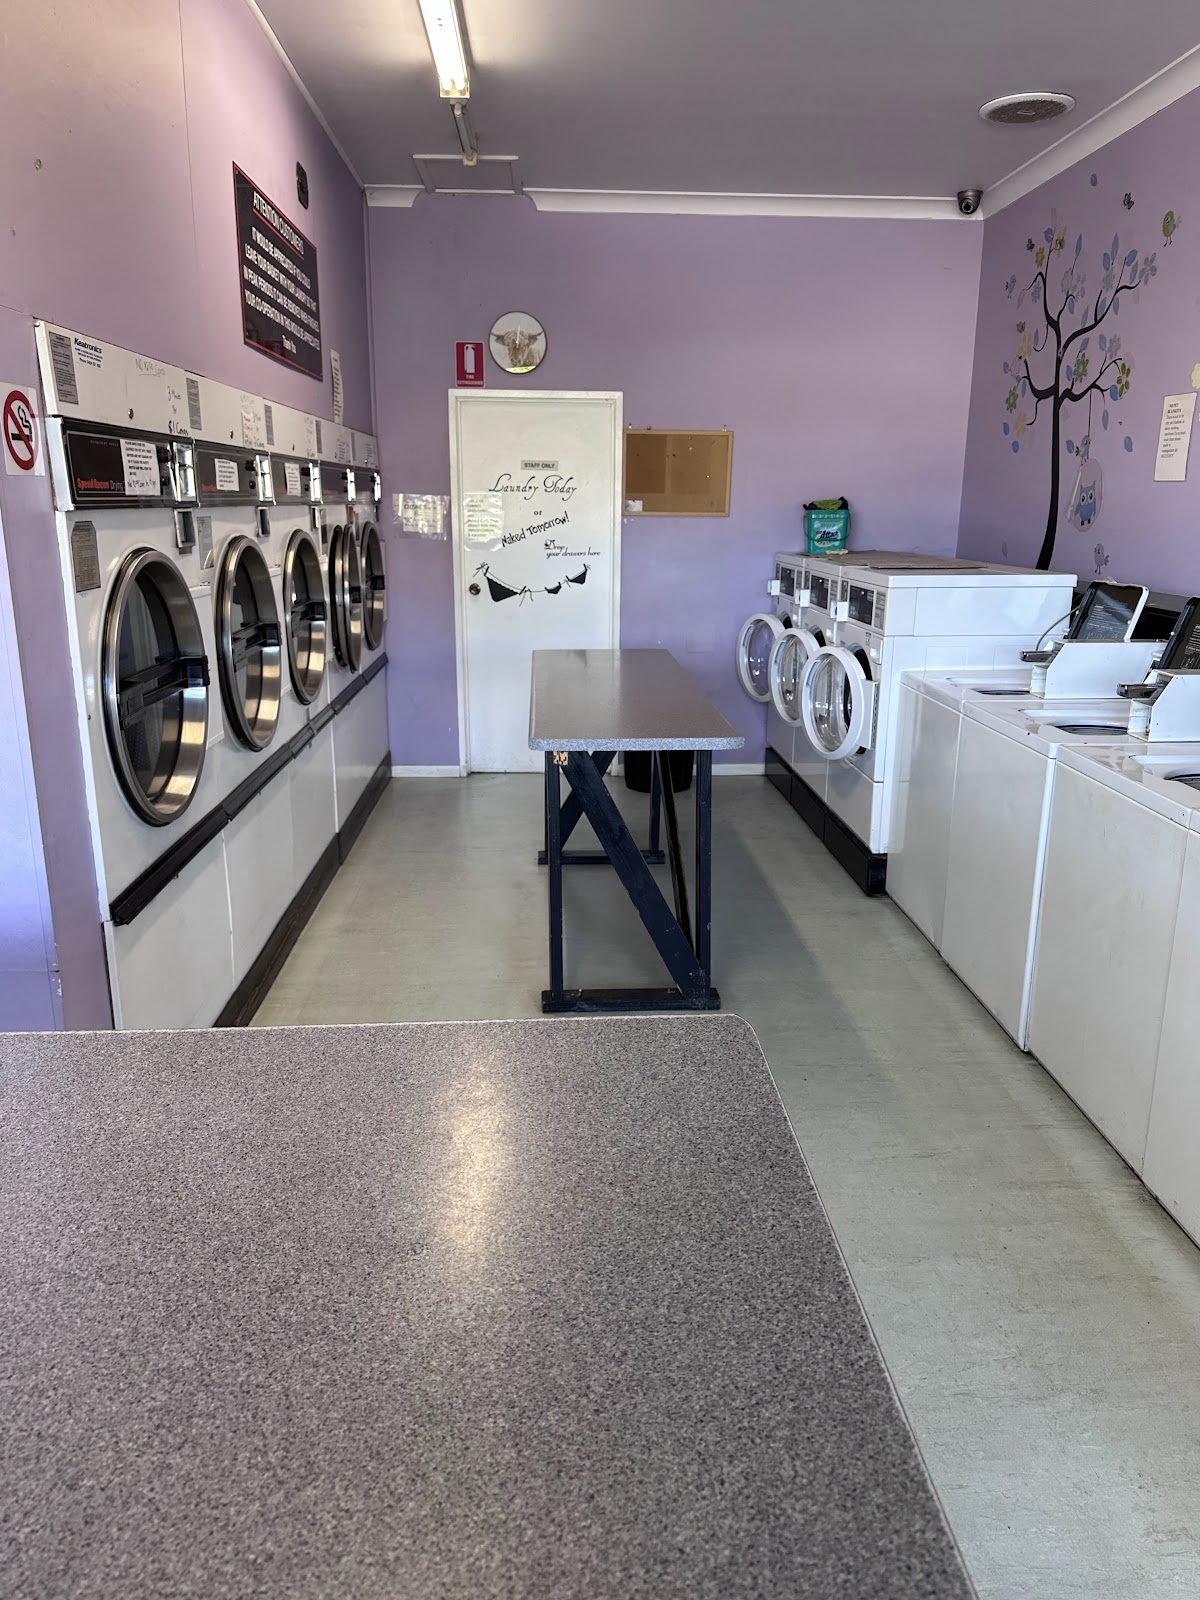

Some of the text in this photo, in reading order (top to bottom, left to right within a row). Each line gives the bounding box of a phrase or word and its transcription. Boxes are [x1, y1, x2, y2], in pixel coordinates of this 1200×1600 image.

[253, 190, 304, 255] ATTENTION CUSTOMERS
[245, 243, 258, 265] LEAVE
[249, 269, 259, 288] PEAK
[259, 277, 273, 299] PERIODS
[245, 289, 256, 309] YOUR
[256, 298, 281, 324] CO-OPERATION
[488, 473, 578, 502] Laundry Today
[502, 528, 526, 547] Naked
[544, 539, 565, 552] Drop
[546, 546, 602, 560] your drawers here
